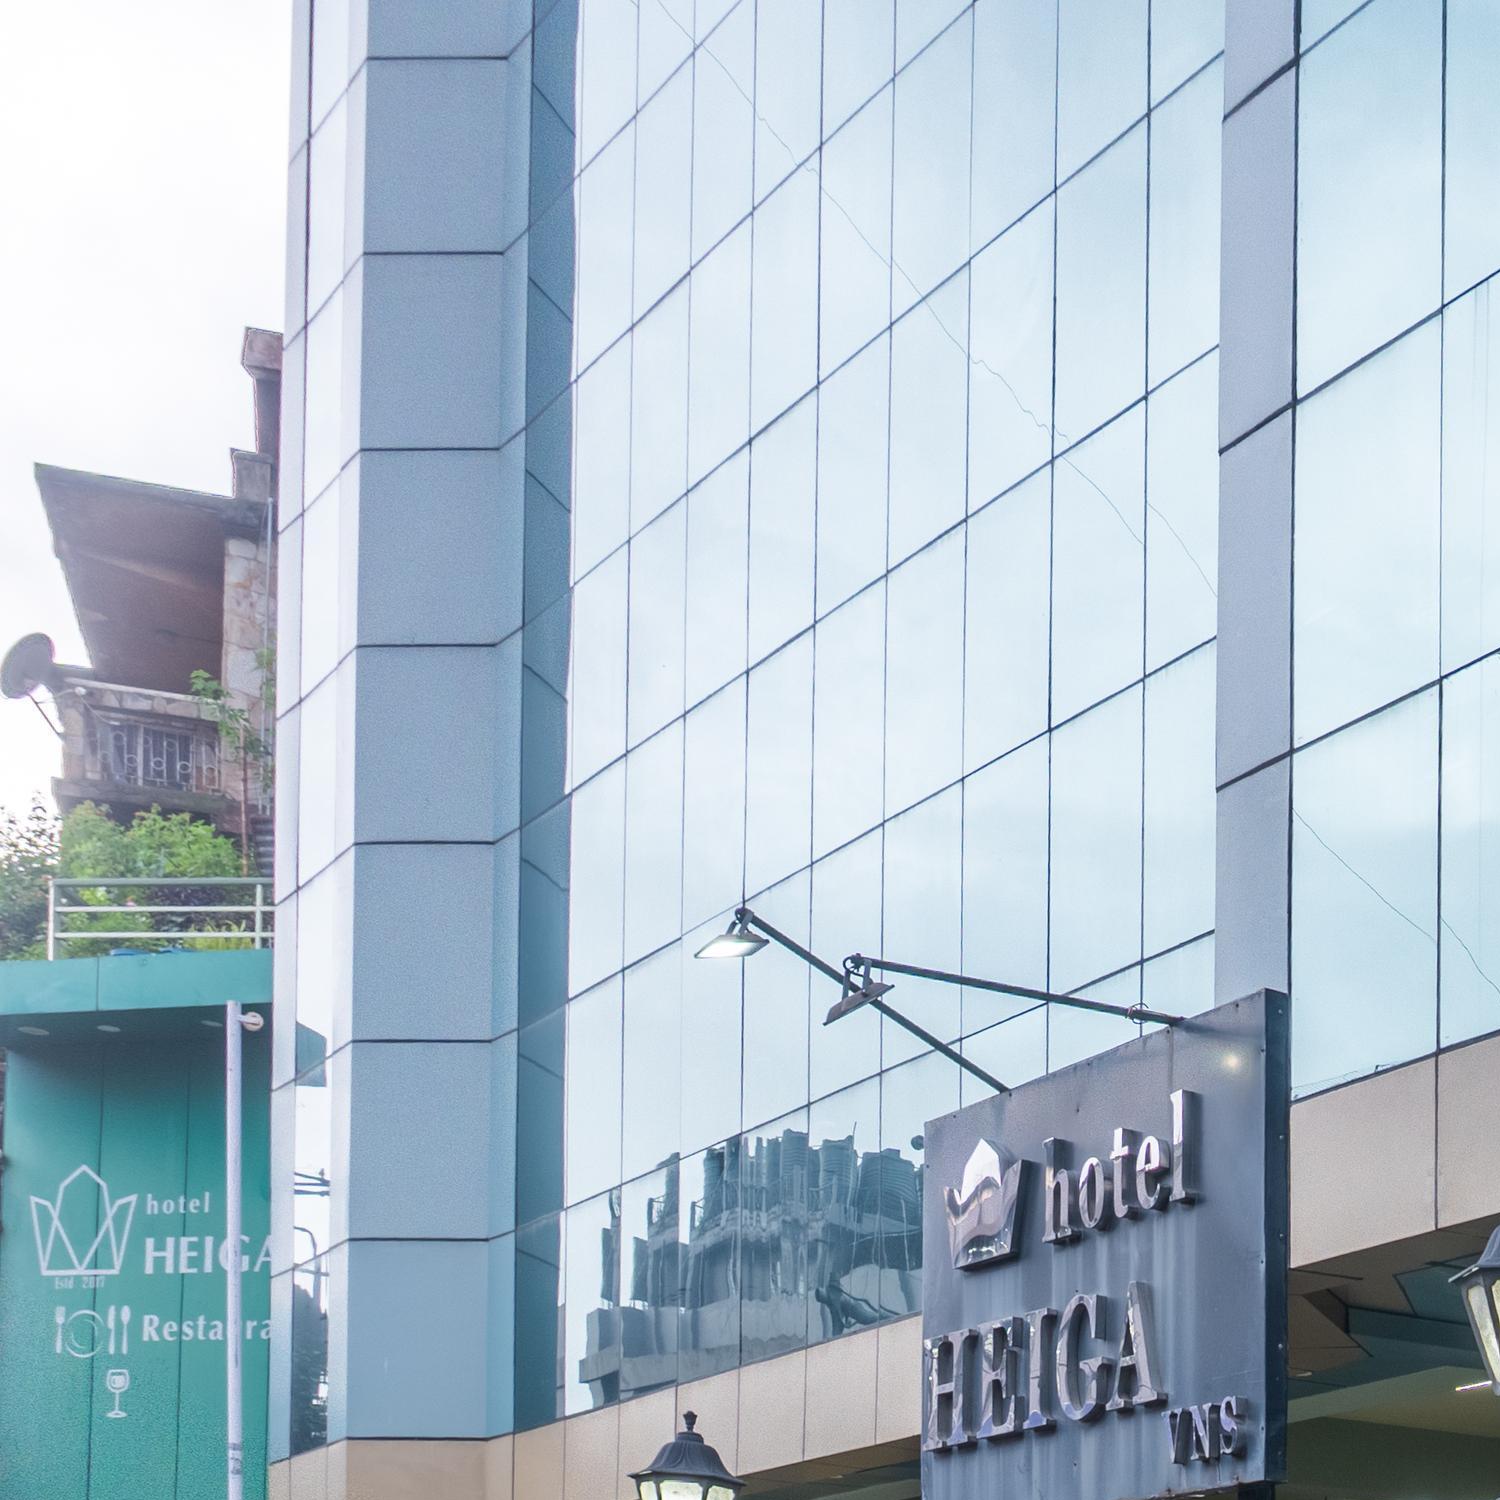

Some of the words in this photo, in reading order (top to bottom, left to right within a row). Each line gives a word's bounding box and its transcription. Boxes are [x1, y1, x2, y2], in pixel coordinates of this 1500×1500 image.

[146, 1192, 210, 1215] hotel
[1042, 1089, 1200, 1244] hotel
[923, 1281, 1168, 1451] HEIGA
